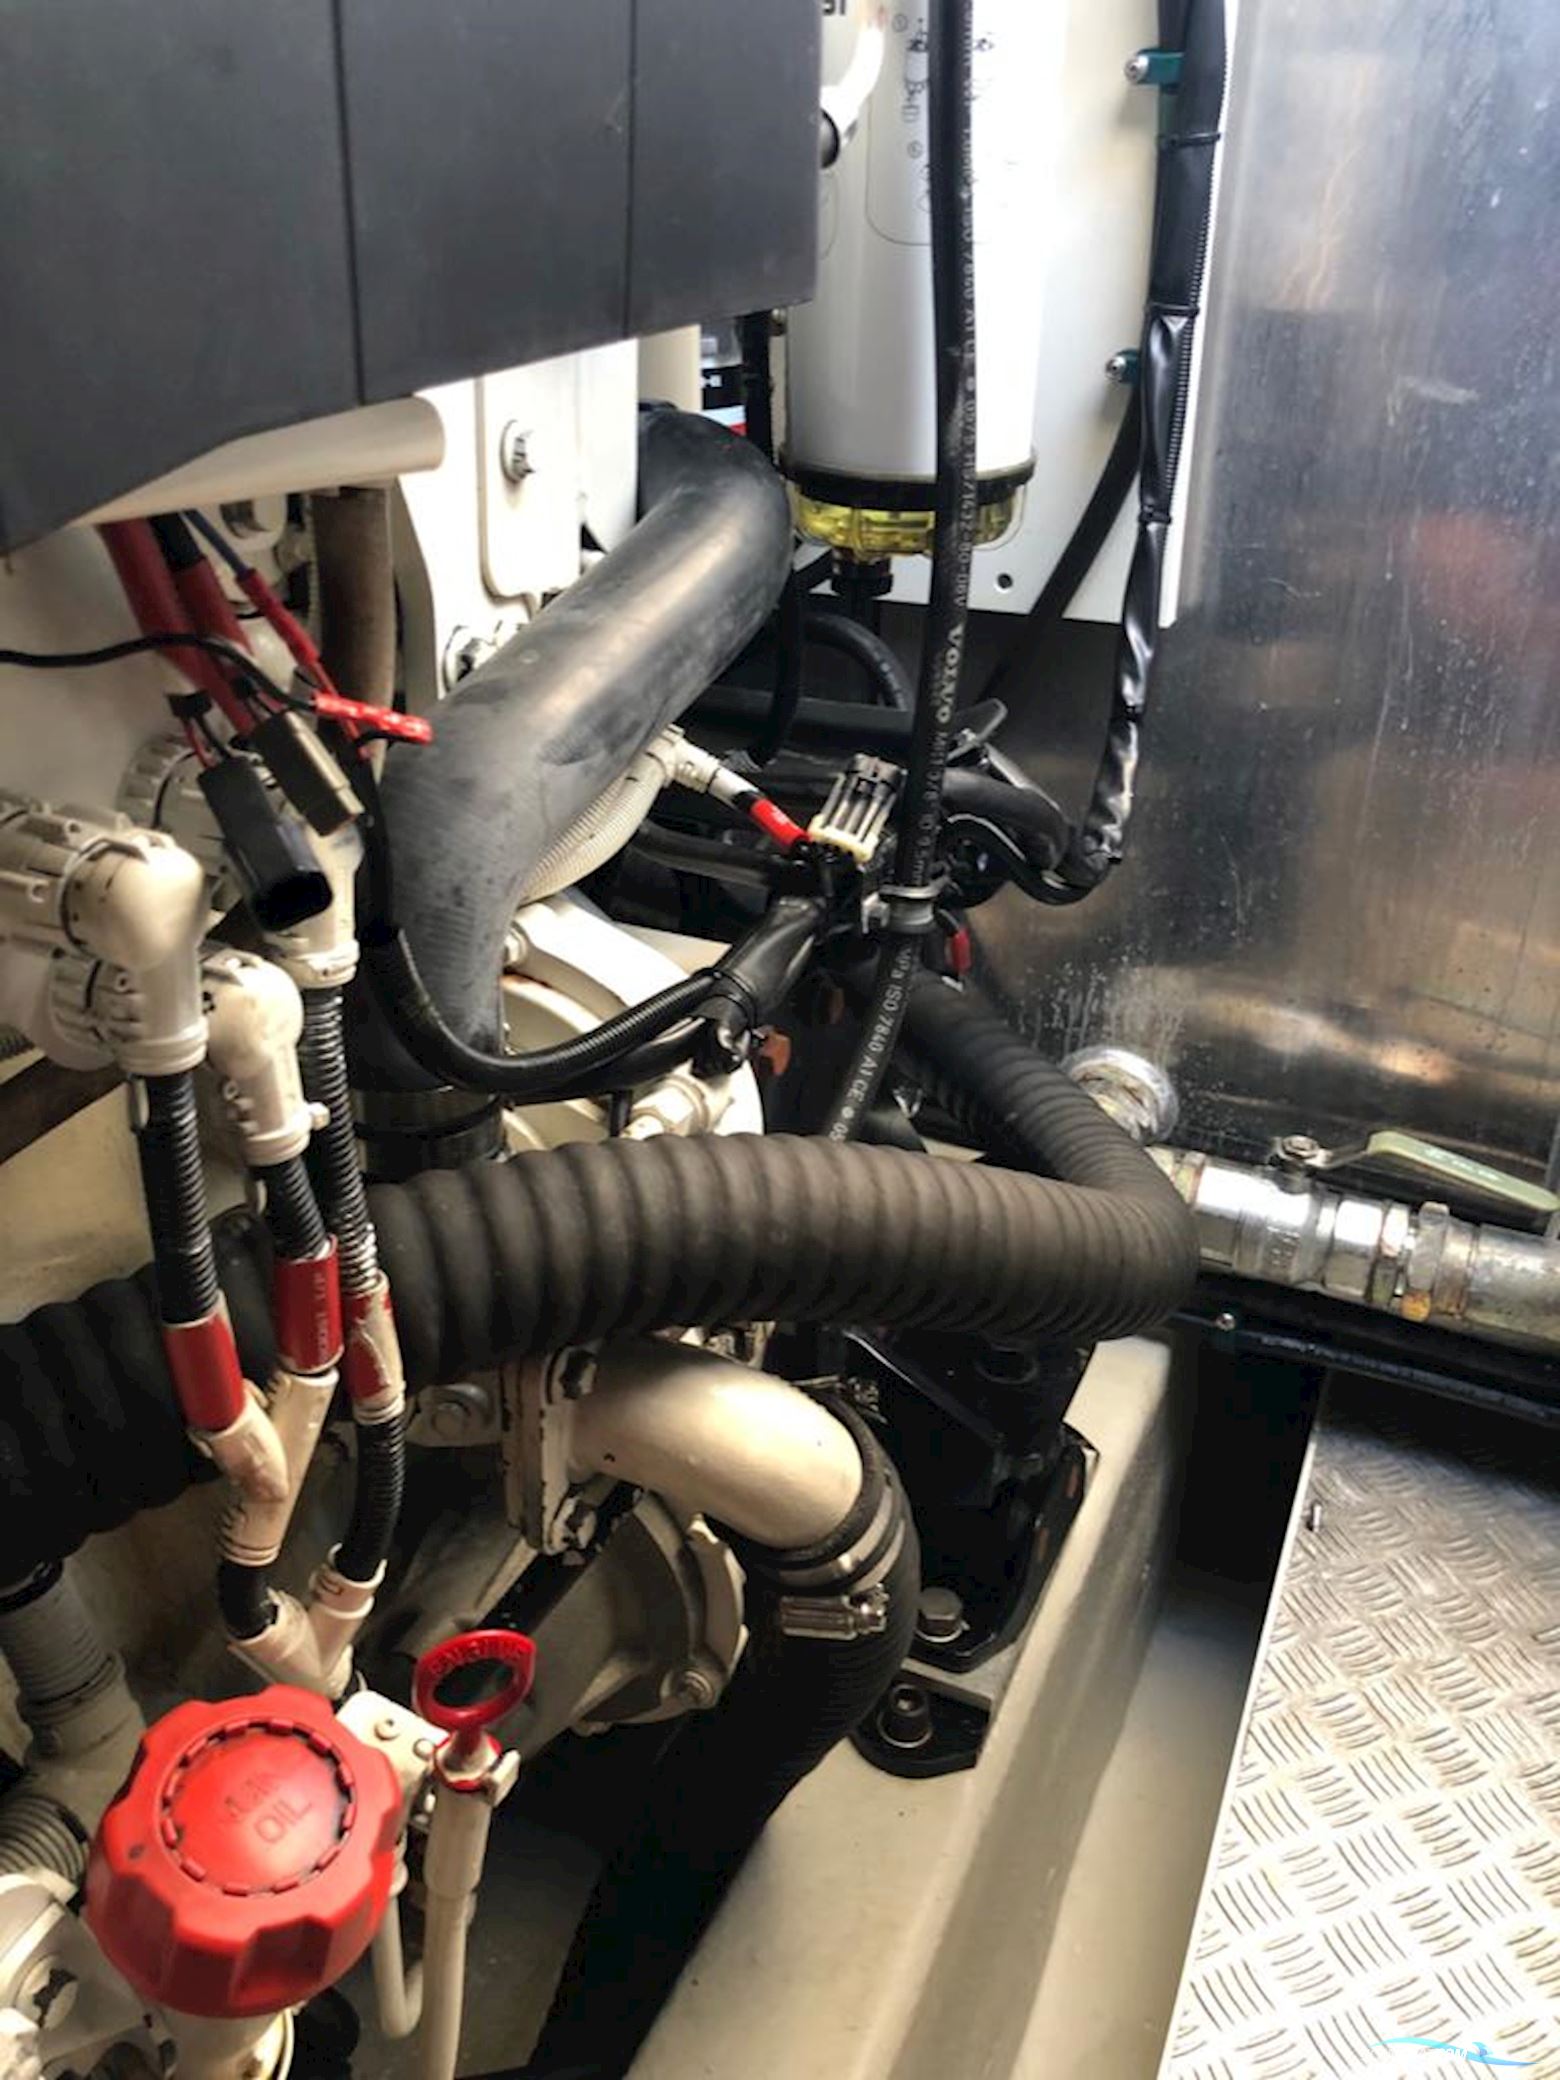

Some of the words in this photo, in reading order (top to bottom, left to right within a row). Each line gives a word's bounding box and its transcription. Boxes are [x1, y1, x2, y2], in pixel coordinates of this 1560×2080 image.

[936, 622, 964, 724] VOLVO
[882, 984, 903, 1013] ISO
[868, 1014, 896, 1053] 7840
[846, 1079, 869, 1102] CE
[253, 1799, 313, 1844] OIL
